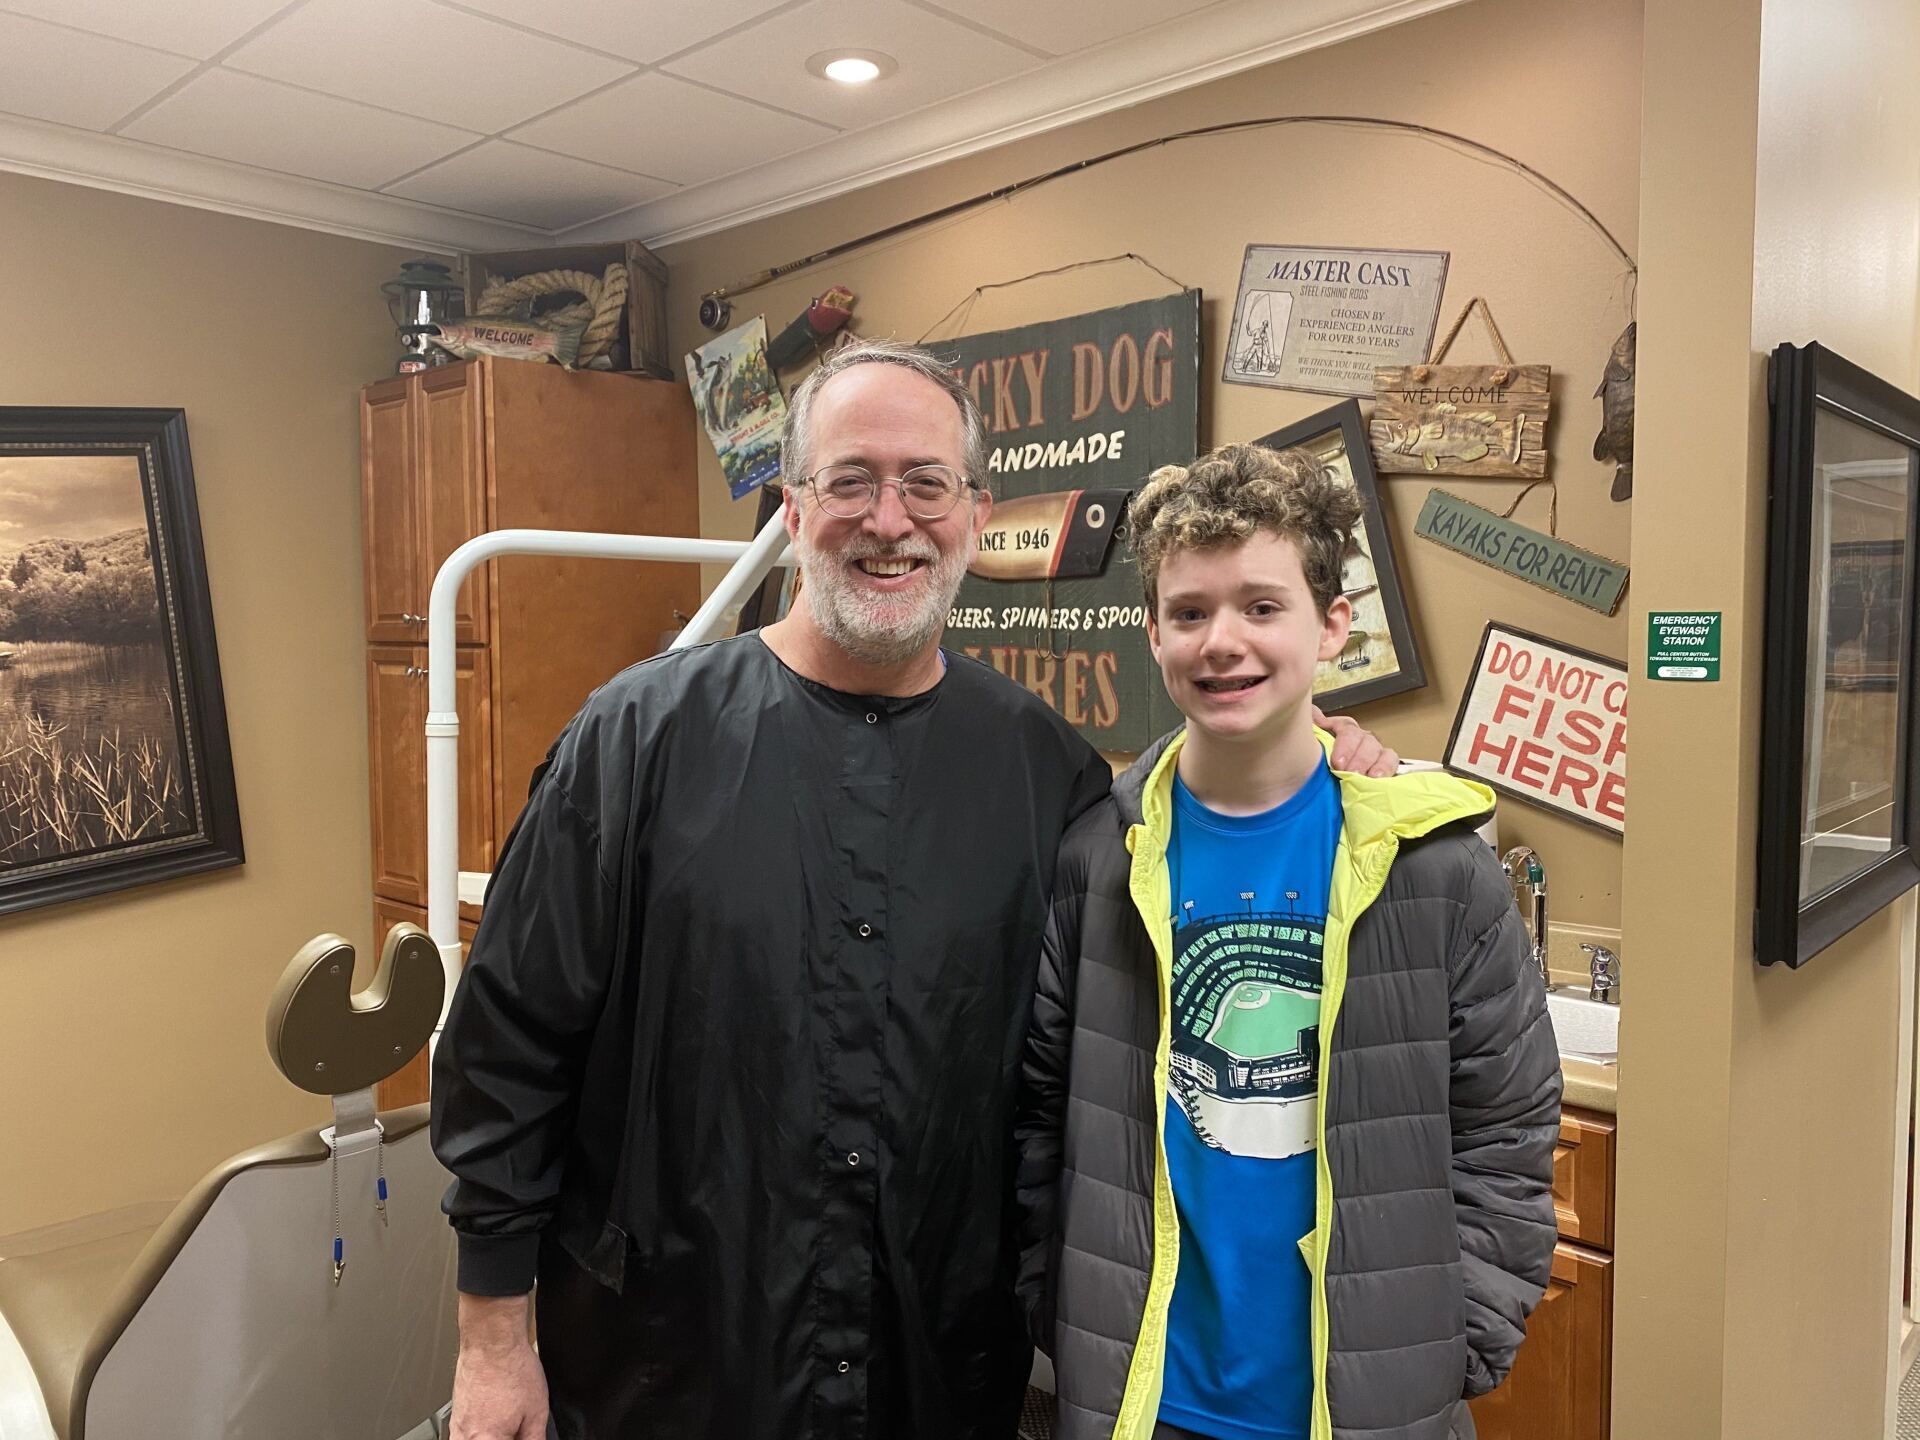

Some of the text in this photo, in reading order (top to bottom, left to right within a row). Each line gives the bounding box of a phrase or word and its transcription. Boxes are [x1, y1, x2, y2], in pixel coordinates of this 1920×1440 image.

[1265, 259, 1413, 288] MASTER CAST
[1299, 285, 1319, 297] STEEL
[1320, 286, 1347, 299] FISHING
[1330, 309, 1386, 321] CHOSEN BY
[472, 327, 534, 346] WELCOME
[1299, 318, 1415, 336] EXPERIENCED ANGLERS
[1307, 331, 1400, 348] FOR OVER 50 YEARS
[1299, 367, 1317, 376] WITH
[1319, 369, 1341, 378] THEIR
[1310, 357, 1333, 368] THINK
[1335, 360, 1351, 369] YOU
[1352, 361, 1372, 371] WILL
[952, 327, 1174, 433] CKY DOG
[1401, 386, 1510, 405] WELCOME
[988, 430, 1125, 473] ANDMADE
[978, 528, 1050, 552] INCE 1946
[1428, 504, 1612, 599] KAYAKS FOR RENT
[1000, 607, 1081, 630] SPINNERS
[1082, 606, 1095, 631] &
[1652, 615, 1718, 625] EMERGENCY
[1659, 626, 1710, 635] EYEWASH
[1662, 636, 1706, 646] STATION
[1487, 641, 1532, 682] DO
[1535, 657, 1604, 704] NOT
[964, 644, 1119, 729] RES
[1467, 723, 1626, 823] HERE
